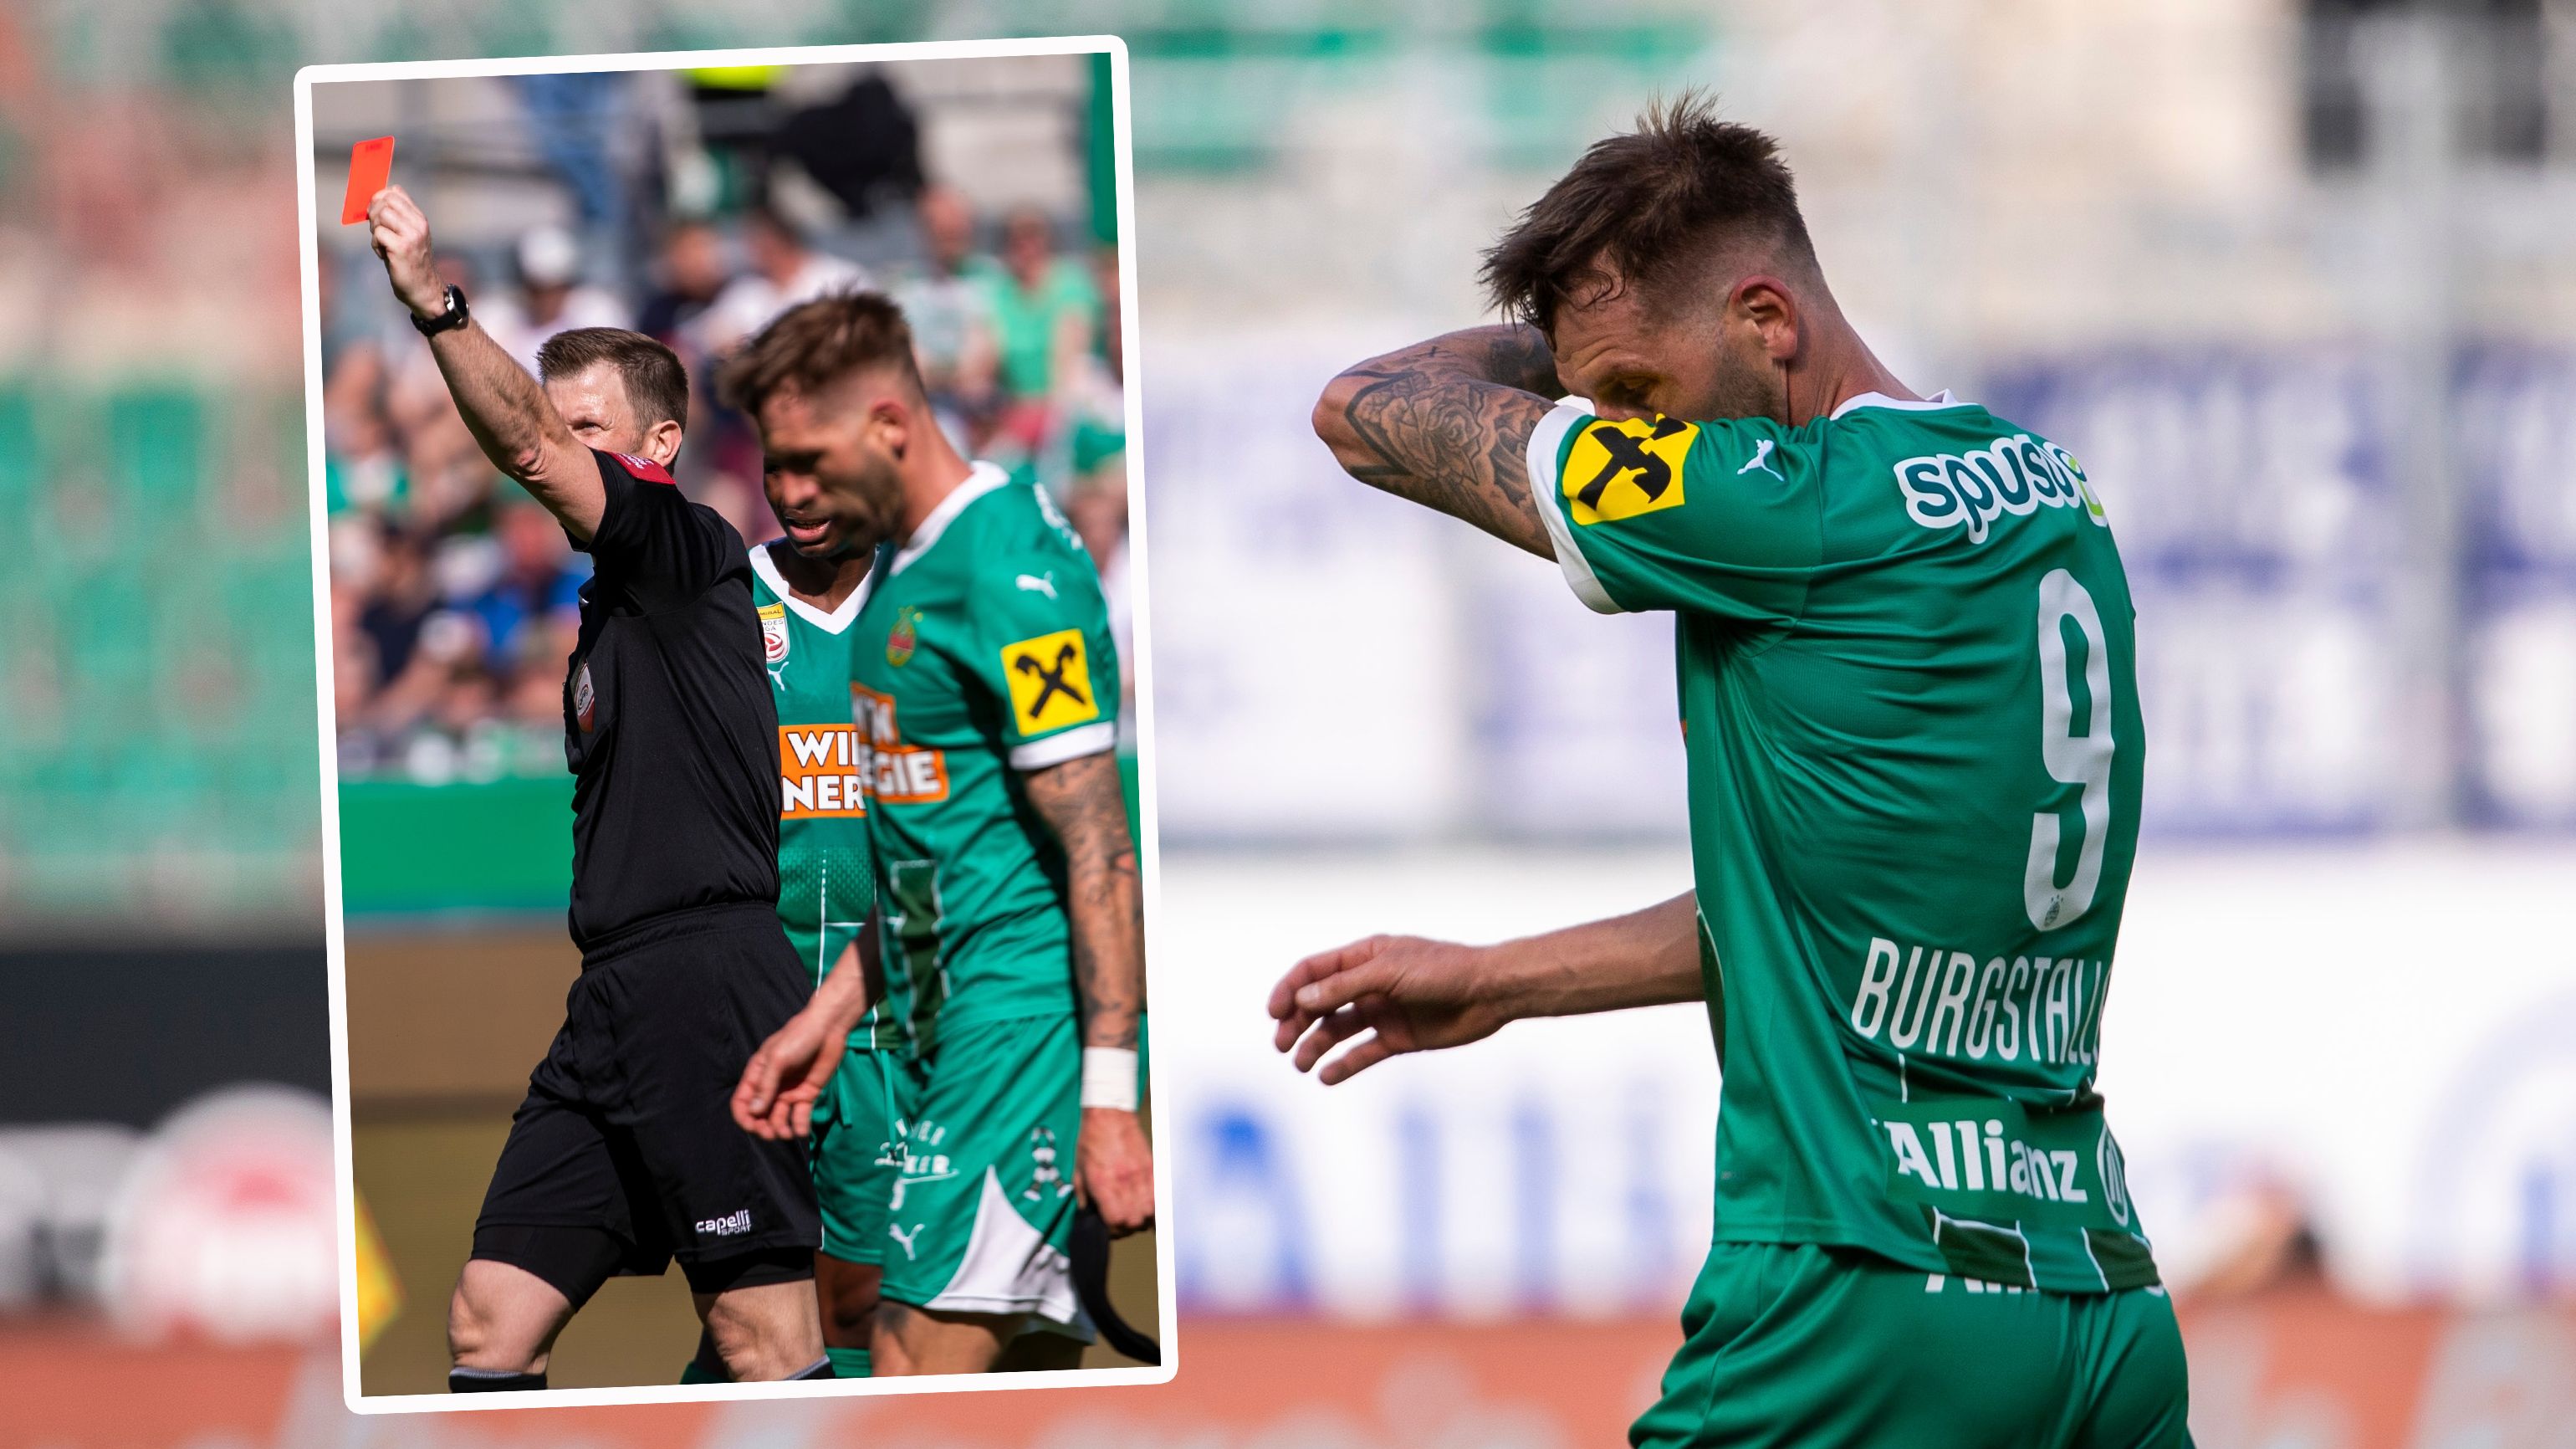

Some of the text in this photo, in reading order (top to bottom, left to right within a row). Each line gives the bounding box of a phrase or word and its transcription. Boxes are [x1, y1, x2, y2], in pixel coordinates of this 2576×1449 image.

[2024, 568, 2115, 932] 9
[1851, 936, 2106, 1066] BURGSTALL
[1883, 1119, 2088, 1203] Allianz
[695, 1209, 750, 1236] capelli
